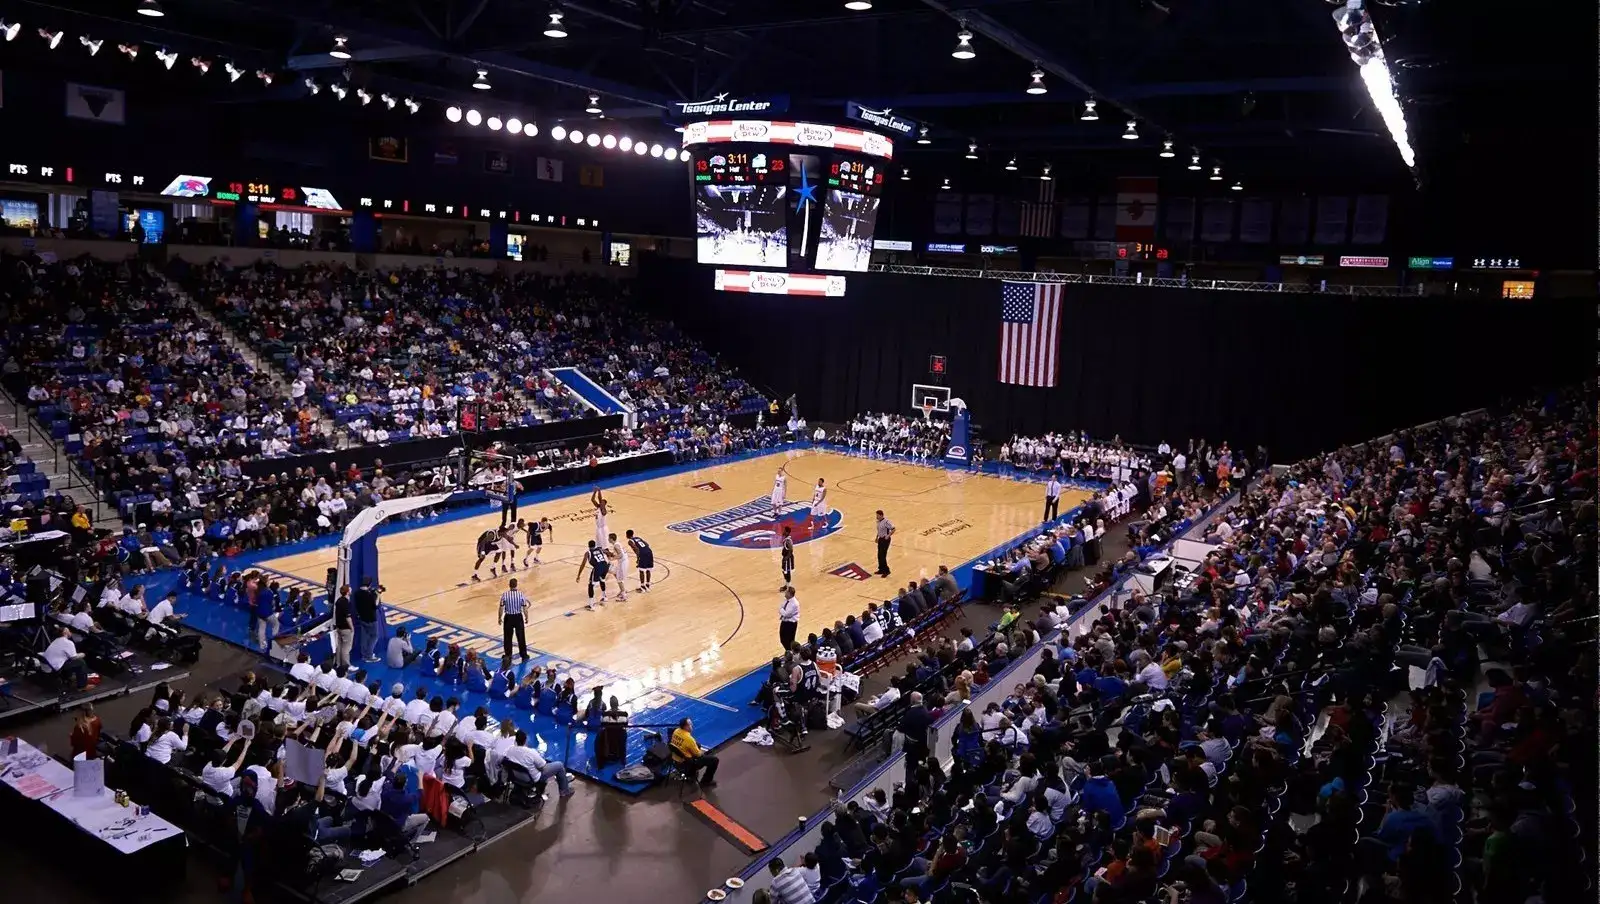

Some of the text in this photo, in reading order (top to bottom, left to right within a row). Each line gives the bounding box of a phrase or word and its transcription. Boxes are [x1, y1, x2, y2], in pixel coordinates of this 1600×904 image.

[681, 99, 770, 115] Tsongas Center
[859, 109, 912, 132] Tsongas Center
[728, 153, 747, 164] 3:11
[9, 163, 54, 177] PTS PF
[771, 160, 784, 171] 23
[852, 161, 864, 174] 3:11
[105, 173, 145, 185] PTS PF
[229, 183, 243, 195] 13
[248, 182, 269, 195] 3:11
[282, 187, 296, 199] 23
[360, 198, 392, 208] PTS PF
[425, 204, 454, 214] PTS PF
[480, 209, 491, 217] PTS
[530, 214, 554, 223] PTS PF
[1411, 257, 1430, 265] Align
[594, 554, 605, 563] 12
